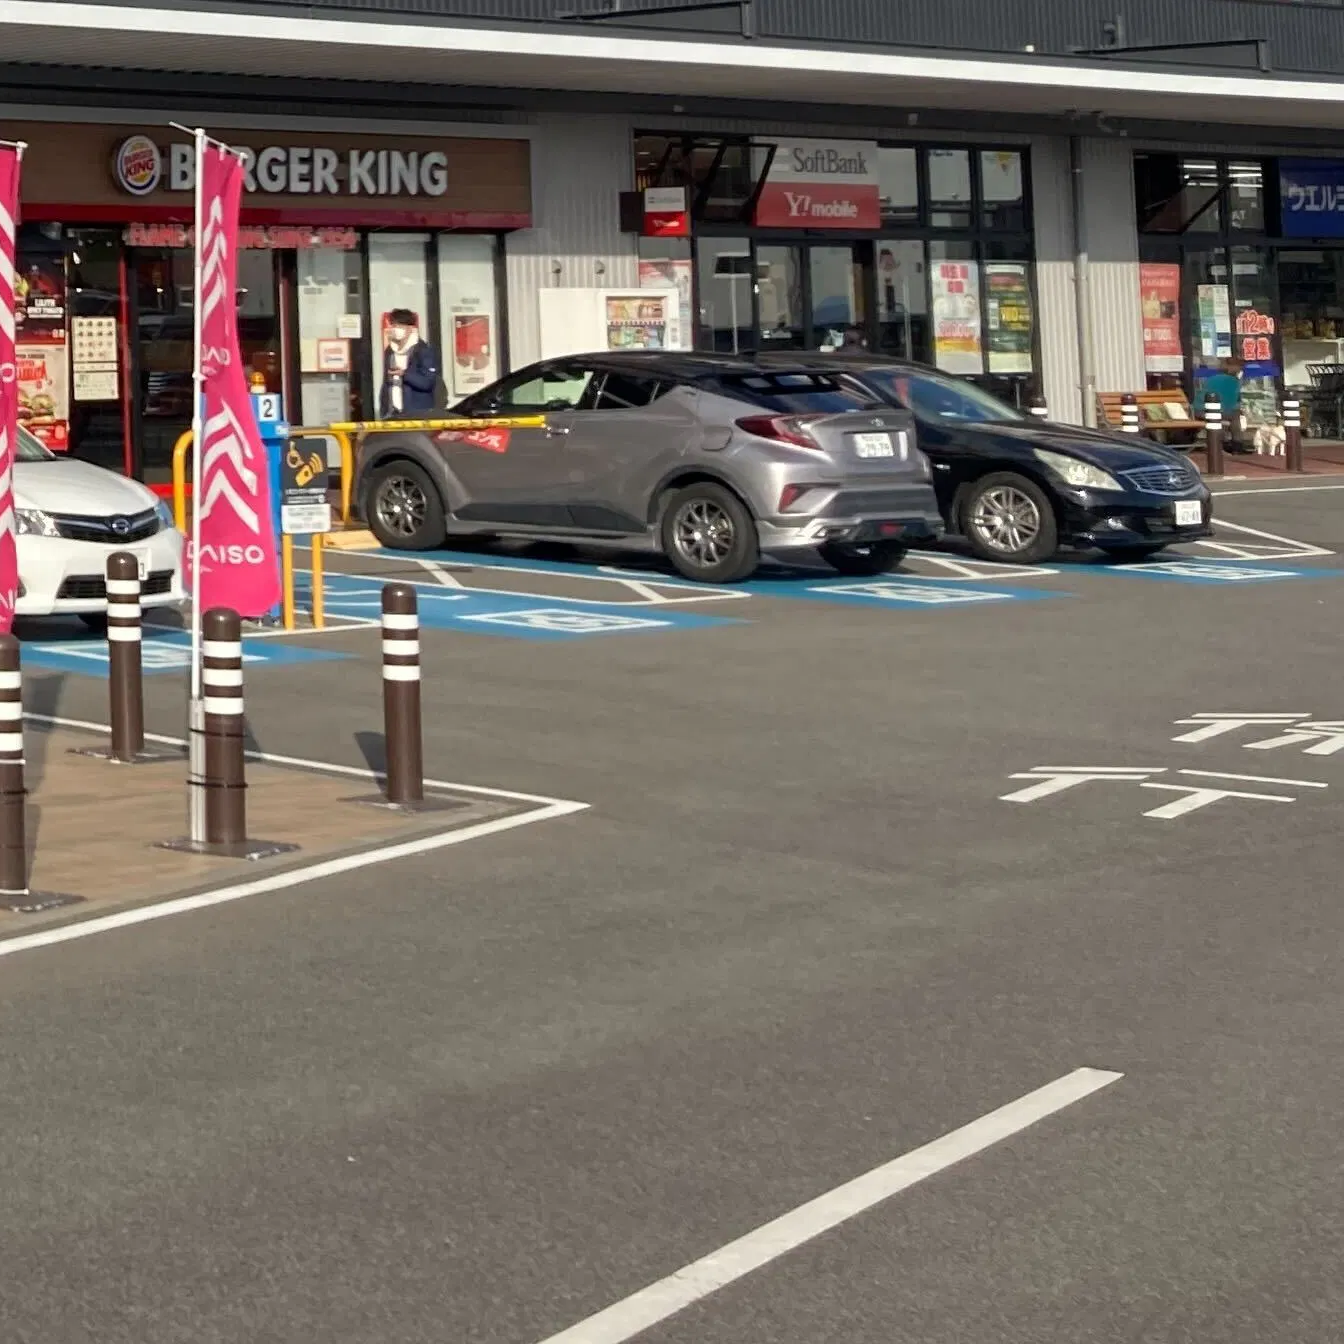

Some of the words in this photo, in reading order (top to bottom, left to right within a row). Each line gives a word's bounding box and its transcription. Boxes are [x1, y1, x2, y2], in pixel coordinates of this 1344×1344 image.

[170, 144, 340, 194] BRGER
[348, 150, 449, 196] KING
[792, 147, 869, 174] SoftBank
[811, 199, 858, 218] mobile
[263, 398, 274, 418] 2
